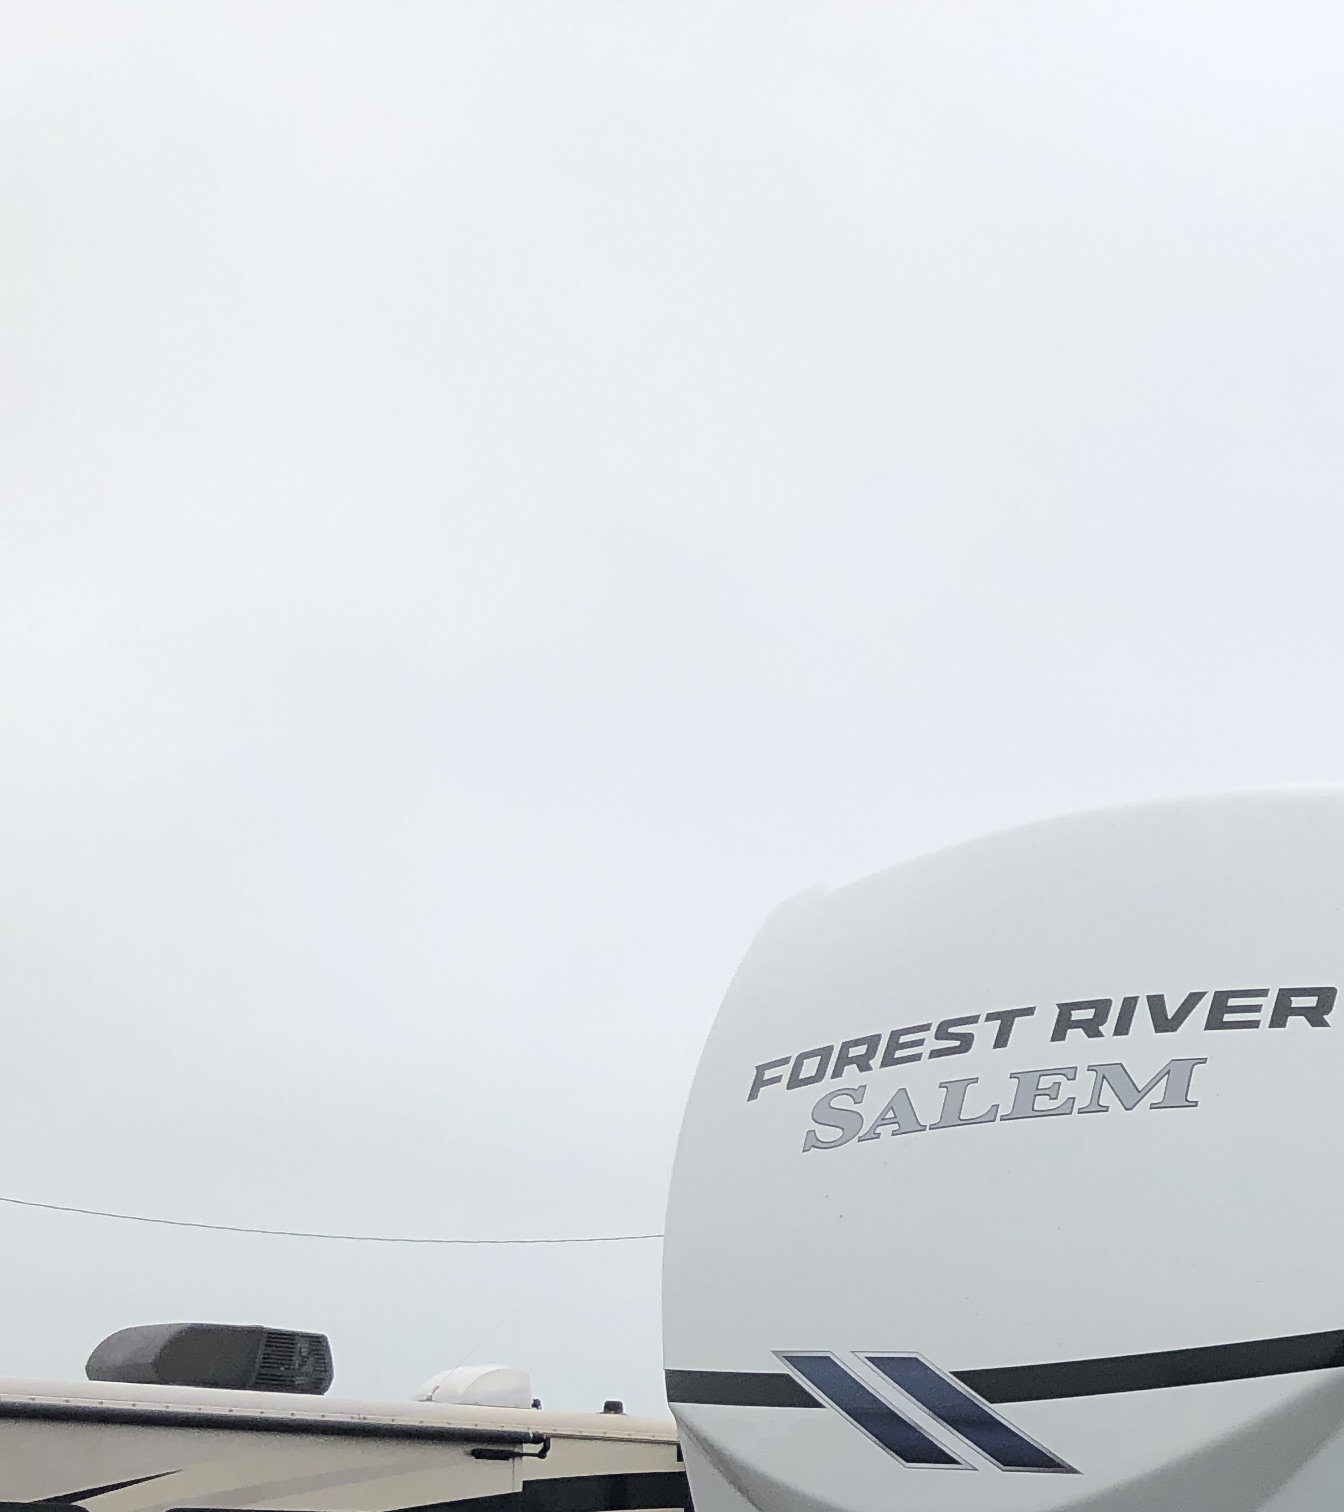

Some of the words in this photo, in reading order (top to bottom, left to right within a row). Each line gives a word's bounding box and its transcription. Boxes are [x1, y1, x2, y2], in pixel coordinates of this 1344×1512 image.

[747, 1005, 1036, 1102] FOREST
[1050, 986, 1338, 1043] RIVER
[802, 1057, 1208, 1153] SALEM
